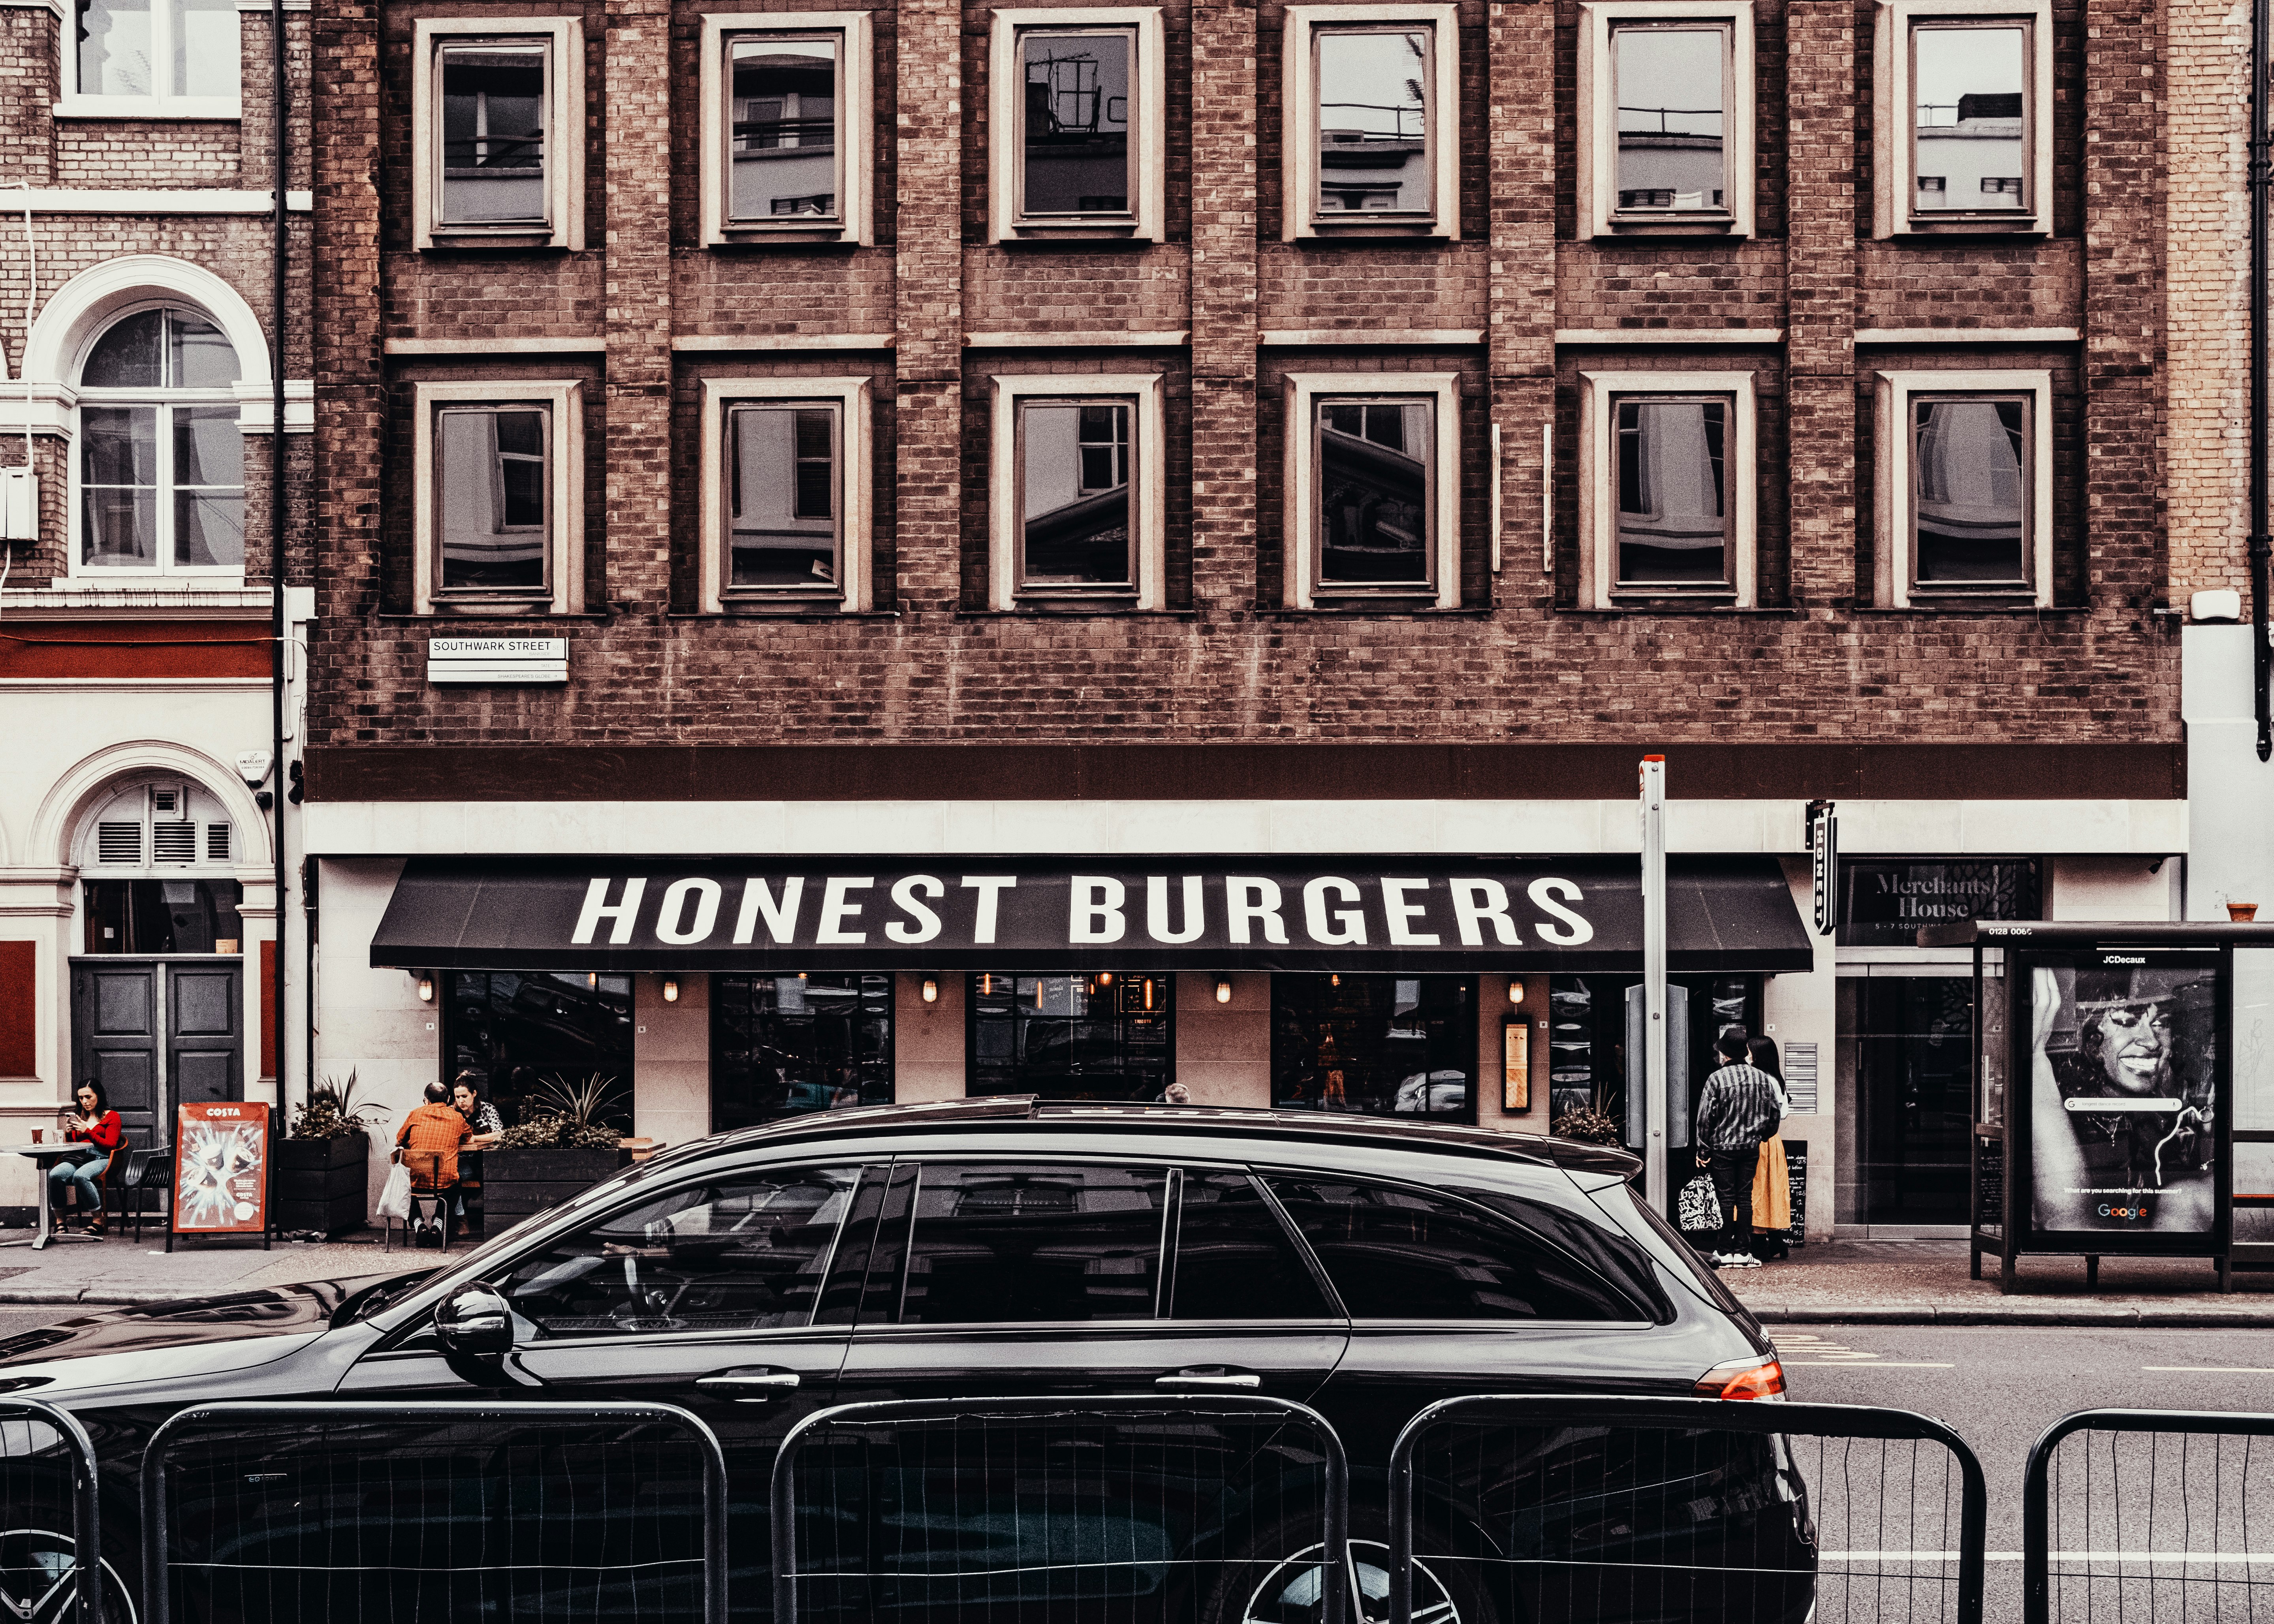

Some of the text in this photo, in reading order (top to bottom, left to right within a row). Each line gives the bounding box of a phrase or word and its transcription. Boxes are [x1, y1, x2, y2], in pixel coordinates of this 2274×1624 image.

[434, 642, 505, 650] SOUTHWARK
[509, 642, 551, 650] STREET
[1876, 874, 1991, 894] Merchants
[571, 875, 1594, 945] HONEST BURGERS
[1899, 897, 1969, 917] House
[207, 1108, 241, 1117] COSTA
[2098, 1204, 2147, 1220] Google
